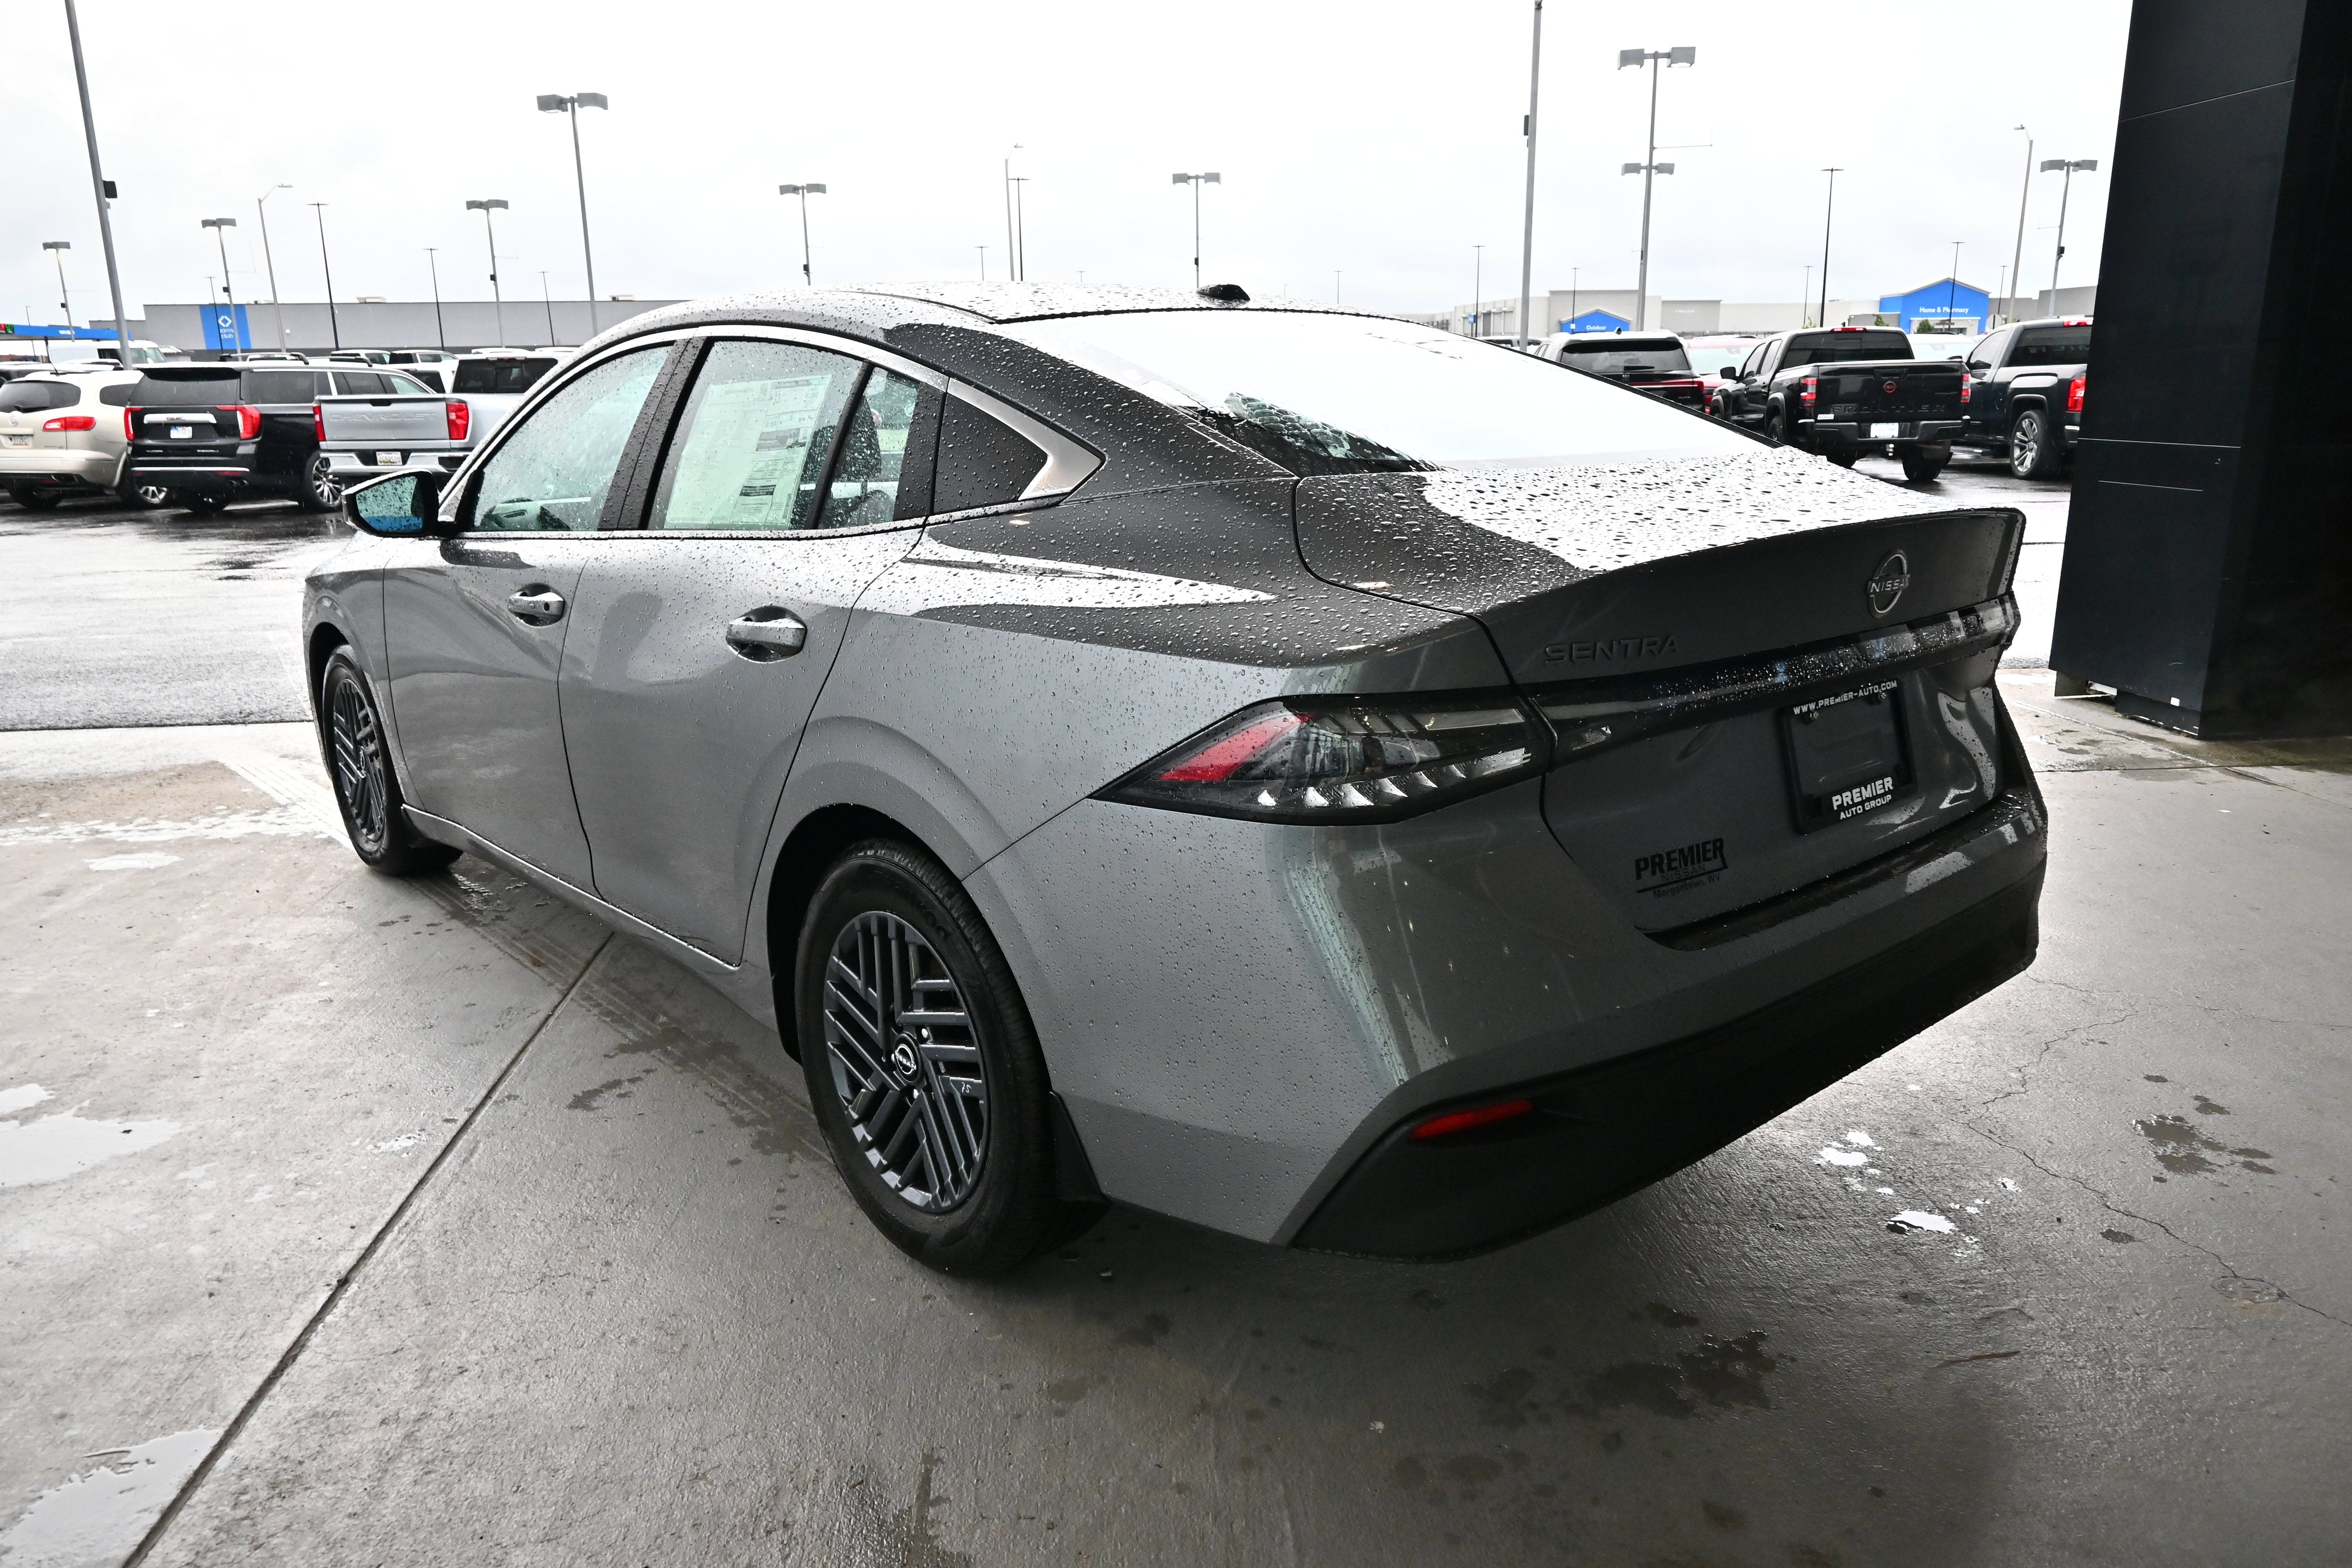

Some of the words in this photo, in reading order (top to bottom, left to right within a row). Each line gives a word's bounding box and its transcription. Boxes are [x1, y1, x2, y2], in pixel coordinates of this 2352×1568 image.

[329, 412, 437, 422] CHEVROLET
[1544, 635, 1677, 662] SENTRA
[1793, 680, 1897, 715] WWW.PREMIER-AUTO.COM
[1832, 776, 1894, 811] PREMIER
[1840, 805, 1863, 820] AUTO
[1864, 794, 1892, 811] GROUP
[1635, 837, 1728, 880] PREMIER
[1661, 865, 1706, 882] NISSAN
[1707, 873, 1720, 883] WV
[895, 1049, 917, 1070] NISSAN
